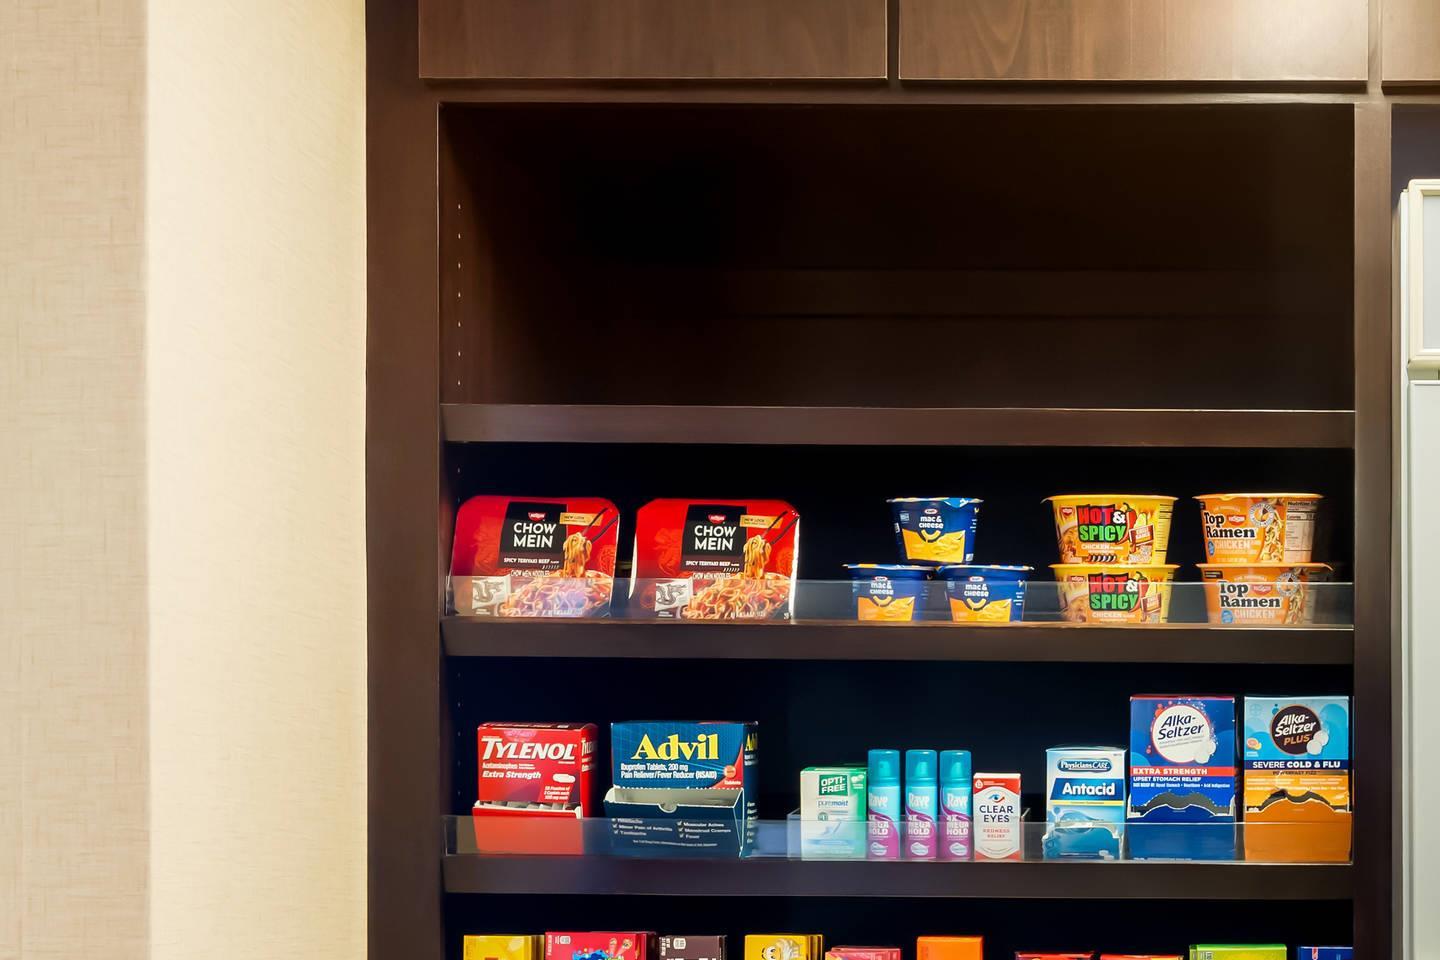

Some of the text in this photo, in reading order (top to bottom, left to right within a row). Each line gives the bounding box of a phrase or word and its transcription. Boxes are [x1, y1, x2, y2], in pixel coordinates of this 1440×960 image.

[1203, 511, 1225, 528] Top
[513, 522, 557, 534] CHOW
[694, 525, 736, 537] CHOW
[1079, 525, 1126, 541] SPICY
[1206, 526, 1255, 539] Ramen
[513, 534, 553, 548] MEIN
[694, 538, 733, 551] MEIN
[1215, 539, 1251, 549] CHICKEN
[1219, 582, 1249, 598] Top
[1090, 594, 1138, 609] SPICY
[1220, 595, 1280, 608] Ramen
[1235, 609, 1276, 618] CHICKEN
[1160, 714, 1196, 729] Alka-
[1278, 714, 1309, 727] Alka-
[1157, 723, 1204, 741] Seltzer
[1274, 721, 1317, 738] Seltzer
[630, 733, 719, 760] Advil
[1284, 735, 1311, 746] PLUS
[481, 738, 577, 760] TYLENOL
[1252, 761, 1285, 769] SEVERE
[505, 771, 541, 780] Strength
[821, 776, 845, 786] OPTI-
[821, 784, 846, 794] FREE
[1062, 782, 1115, 796] Antacid
[907, 793, 930, 808] Rave
[947, 793, 968, 808] Rave
[979, 805, 1014, 813] CLEAR
[983, 815, 1010, 823] EYES
